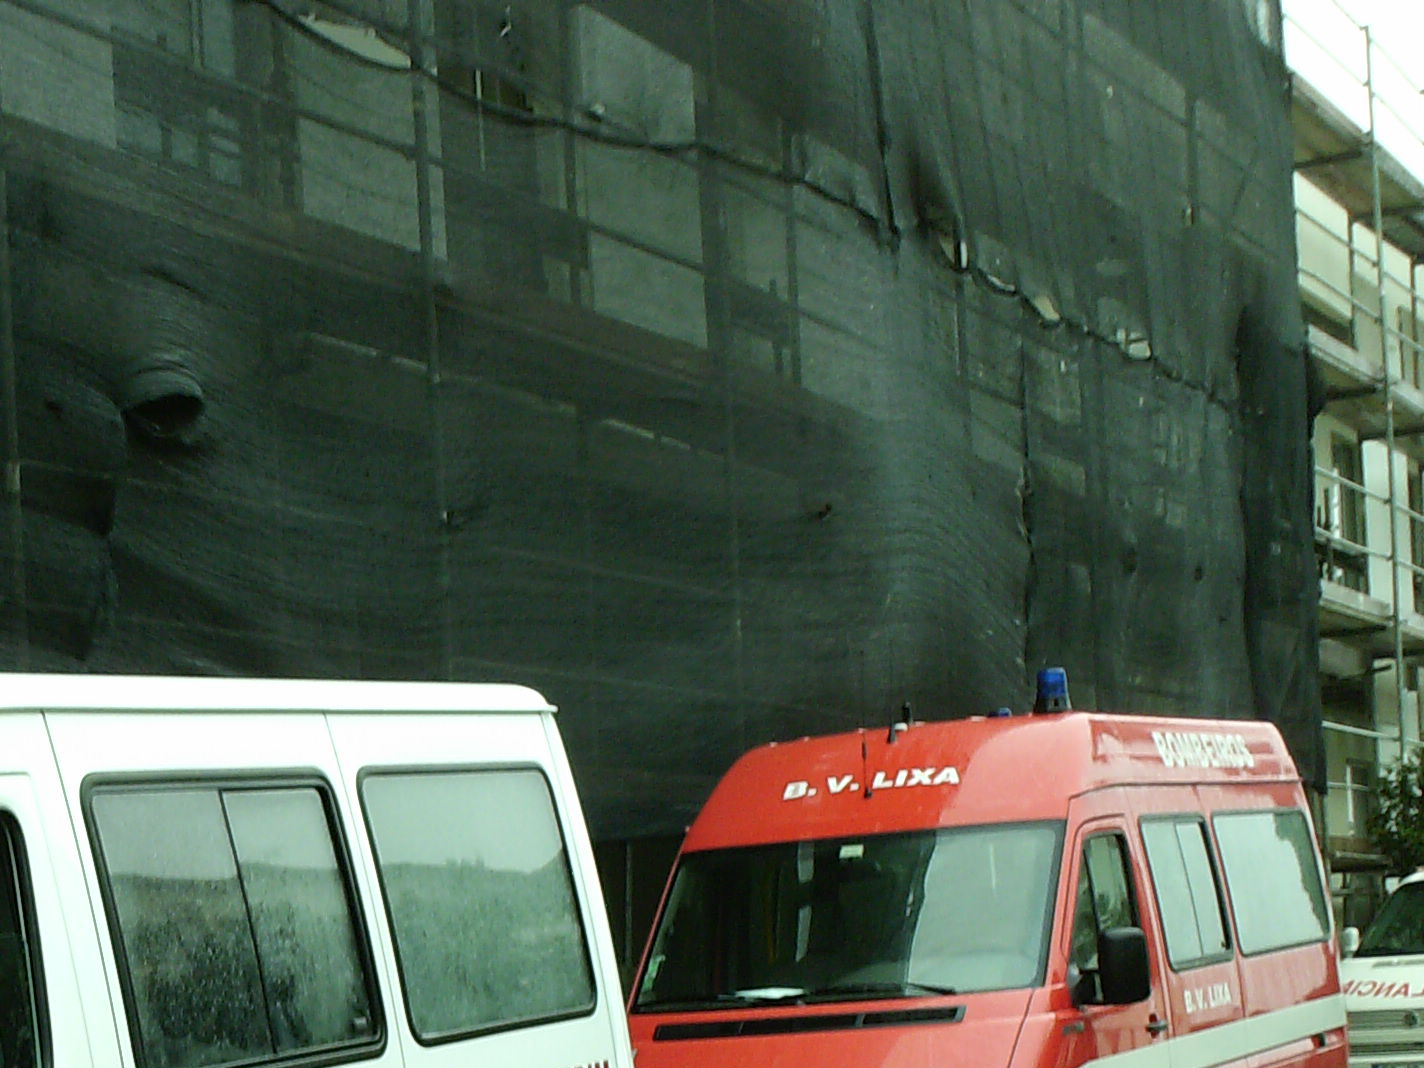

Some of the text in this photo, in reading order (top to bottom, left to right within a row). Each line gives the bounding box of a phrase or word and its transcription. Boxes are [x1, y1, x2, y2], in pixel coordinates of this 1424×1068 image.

[1151, 731, 1255, 769] BOMBEIROS
[783, 766, 960, 801] B. V. LIXA
